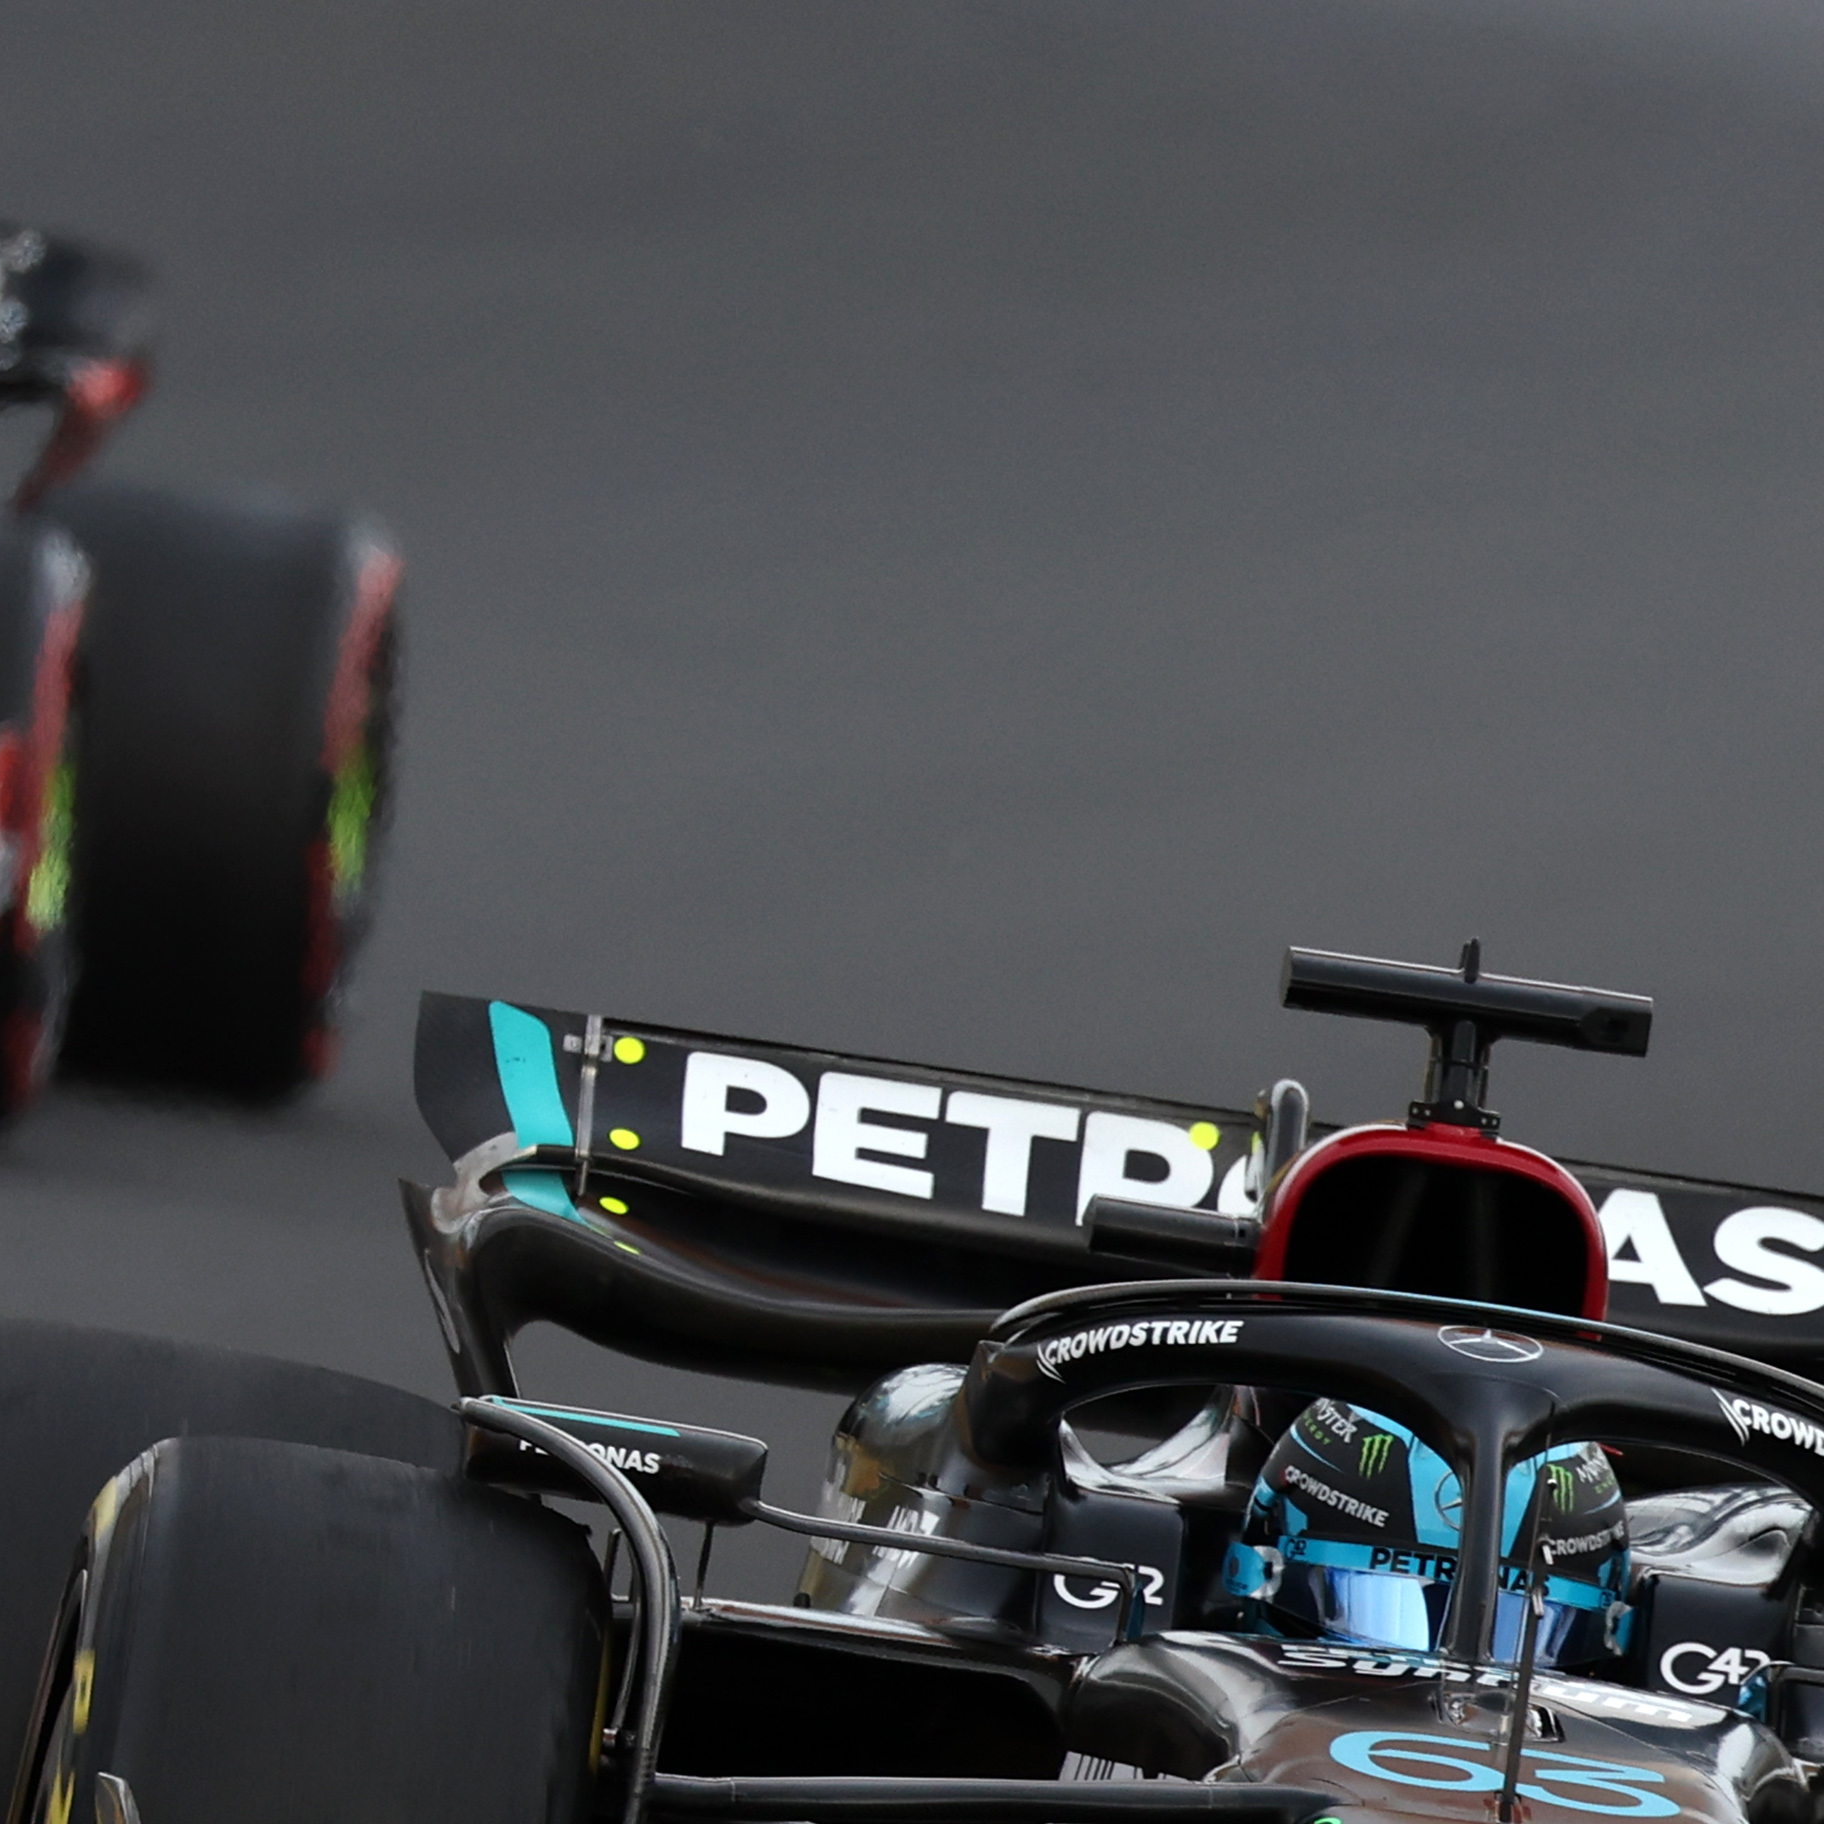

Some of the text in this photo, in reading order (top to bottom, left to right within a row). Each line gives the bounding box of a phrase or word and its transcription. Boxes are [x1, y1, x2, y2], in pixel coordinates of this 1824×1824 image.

[1044, 1320, 1244, 1366] CROWDSTRIKE
[1284, 1464, 1390, 1528] CROWDSTRIKE
[1328, 1730, 1681, 1818] 63
